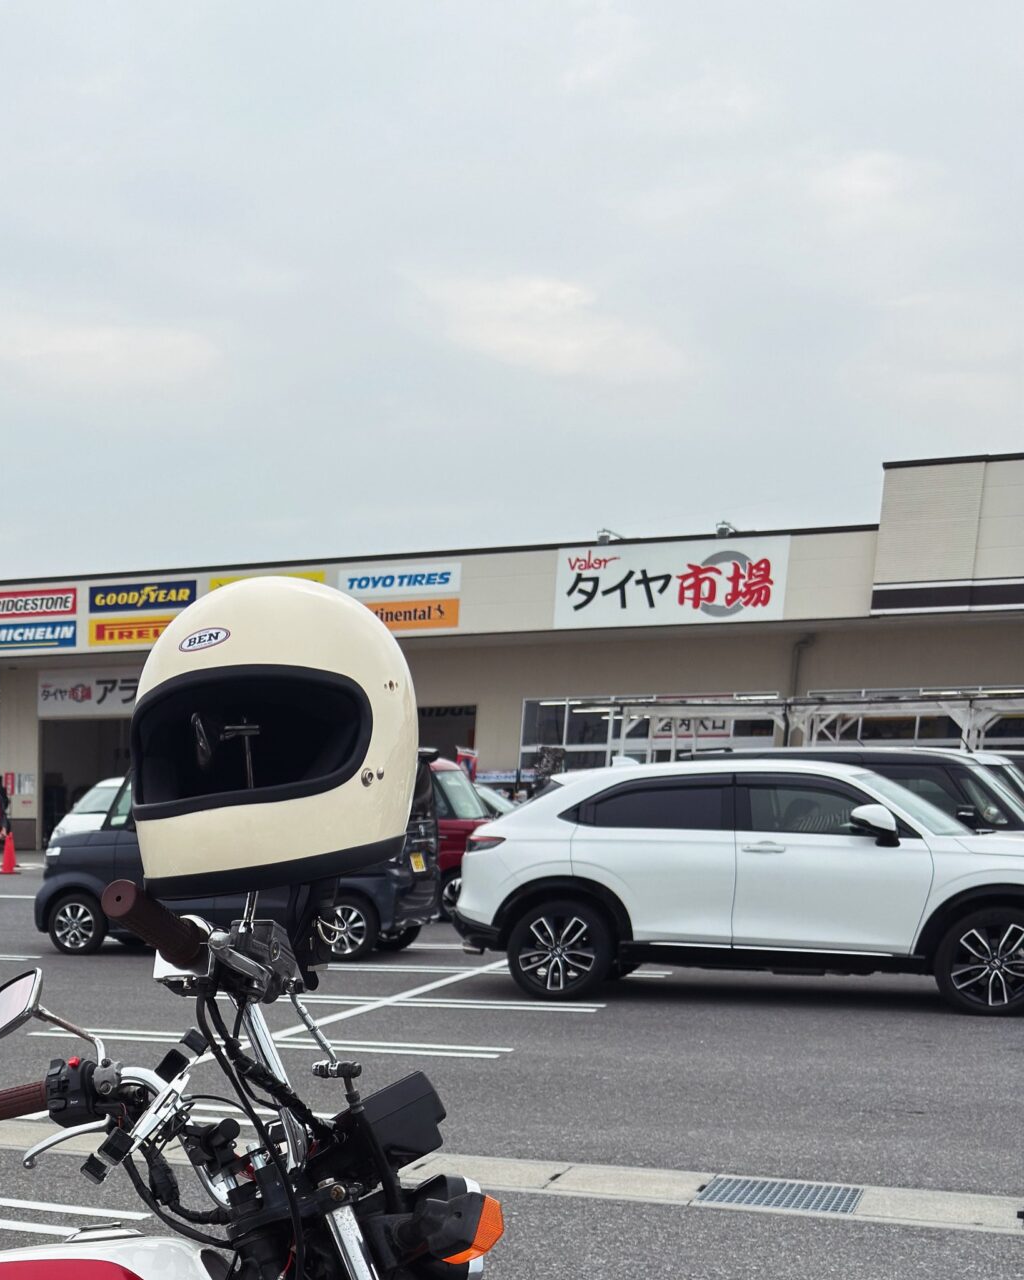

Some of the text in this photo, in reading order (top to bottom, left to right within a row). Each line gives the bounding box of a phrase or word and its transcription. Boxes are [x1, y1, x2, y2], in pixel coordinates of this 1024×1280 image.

[347, 571, 451, 590] TOYO TIRES
[566, 558, 774, 611] タイヤ市場
[374, 605, 432, 622] tinental
[186, 631, 221, 648] BEN
[96, 679, 139, 704] アラ
